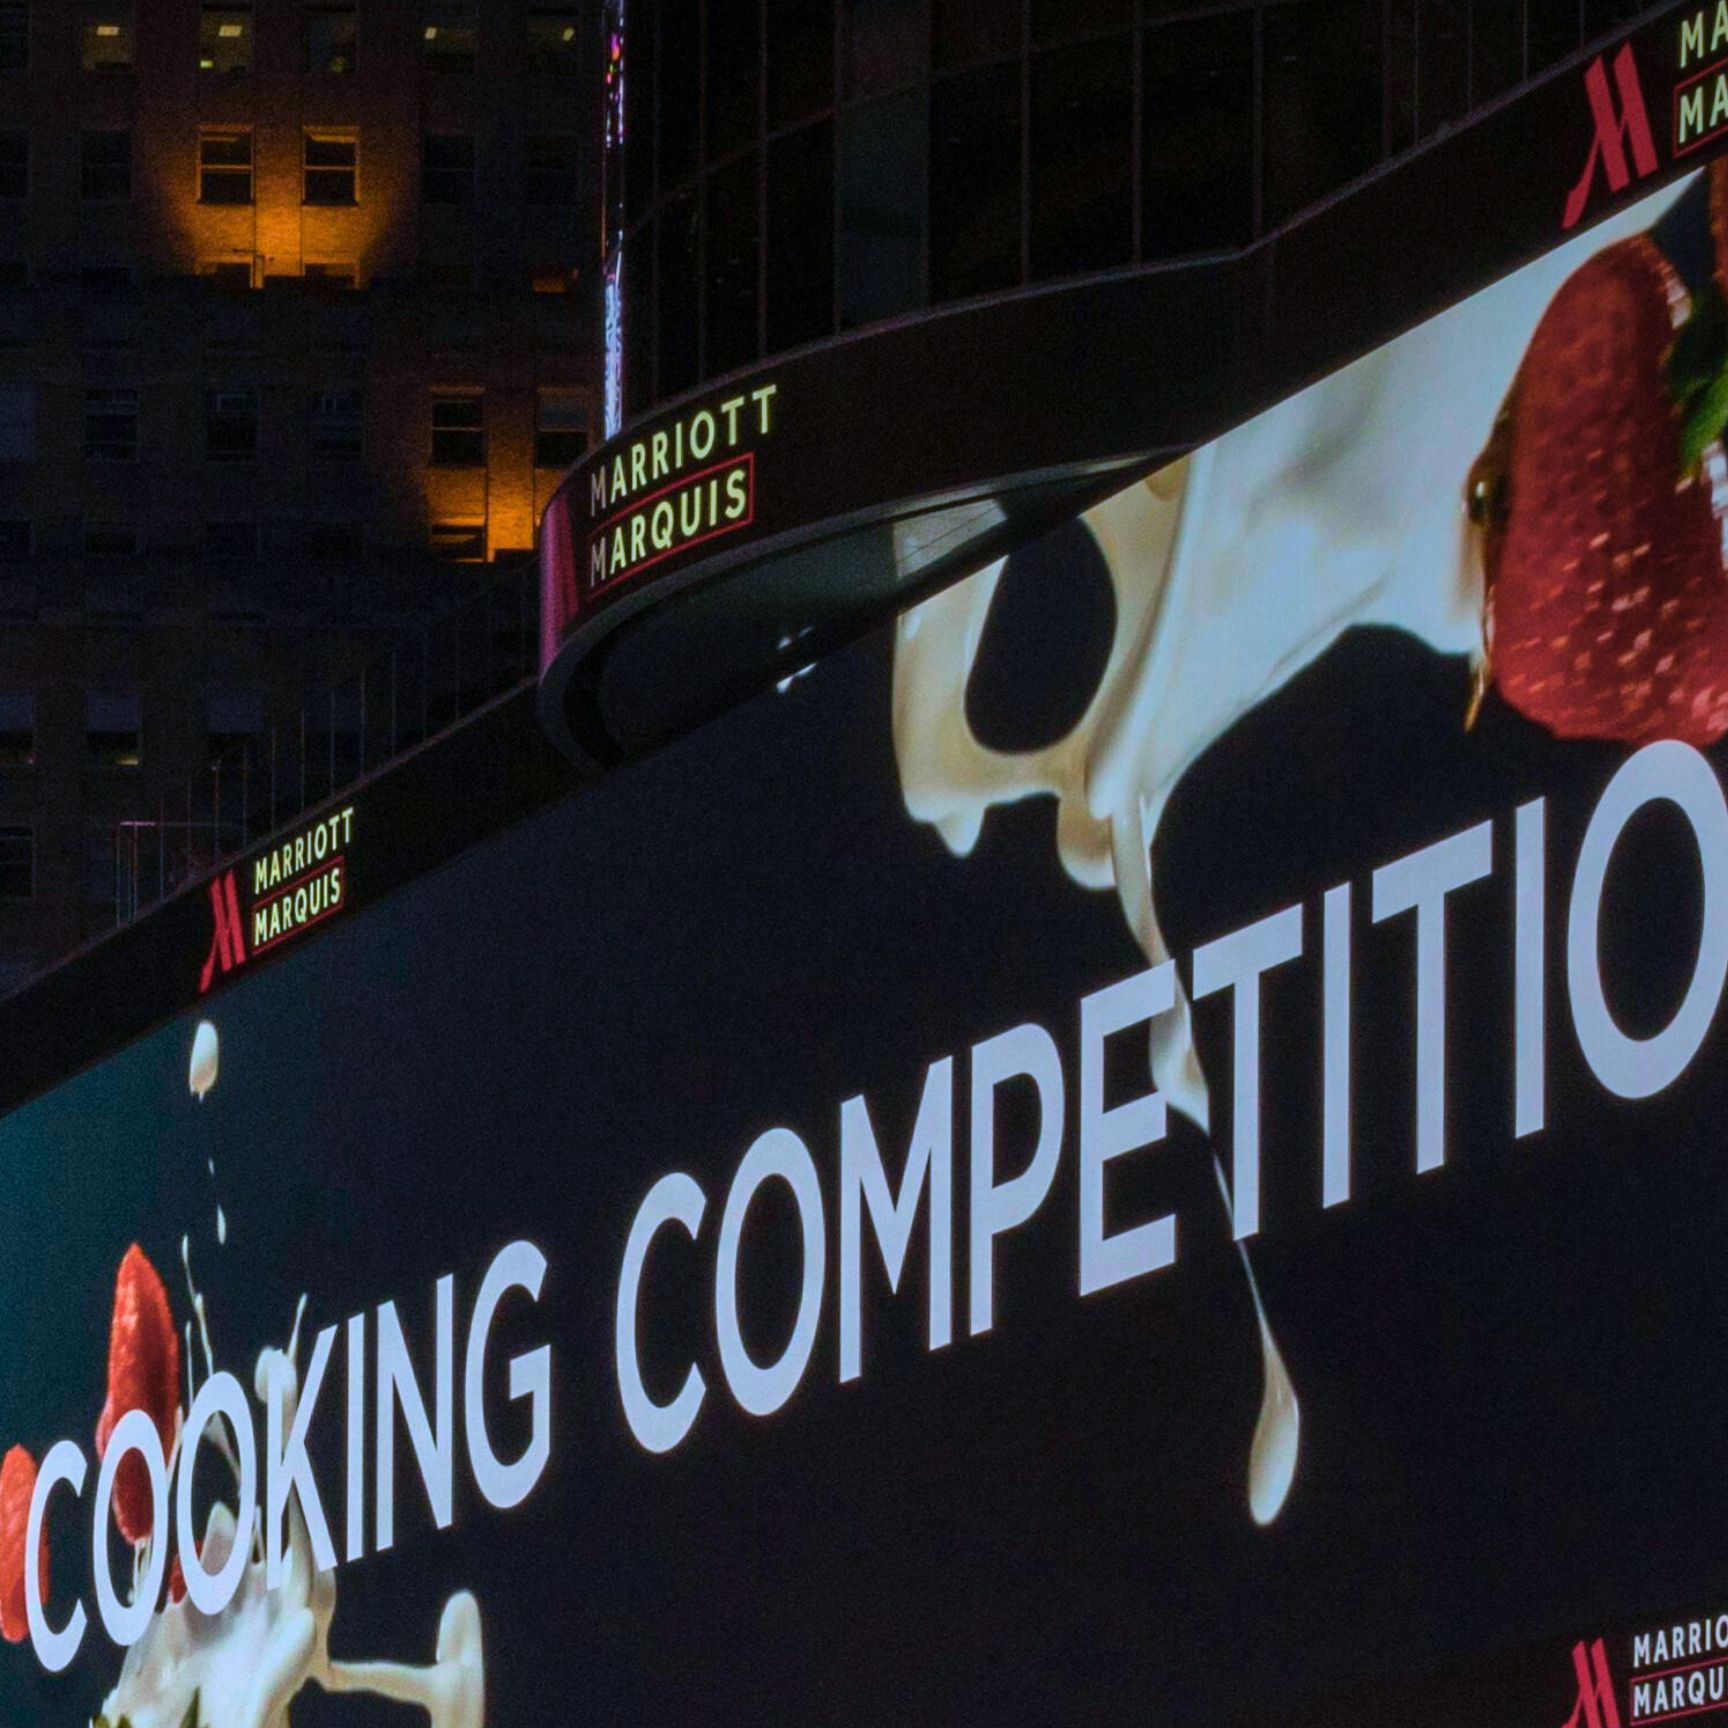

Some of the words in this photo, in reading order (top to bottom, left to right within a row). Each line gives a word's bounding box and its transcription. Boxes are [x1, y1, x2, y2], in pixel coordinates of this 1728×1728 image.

[590, 383, 778, 517] MARRIOTT
[590, 468, 748, 587] MARQUIS
[253, 807, 356, 895] MARRIOTT
[253, 871, 343, 948] MARQUIS
[24, 1240, 553, 1672] COOKING
